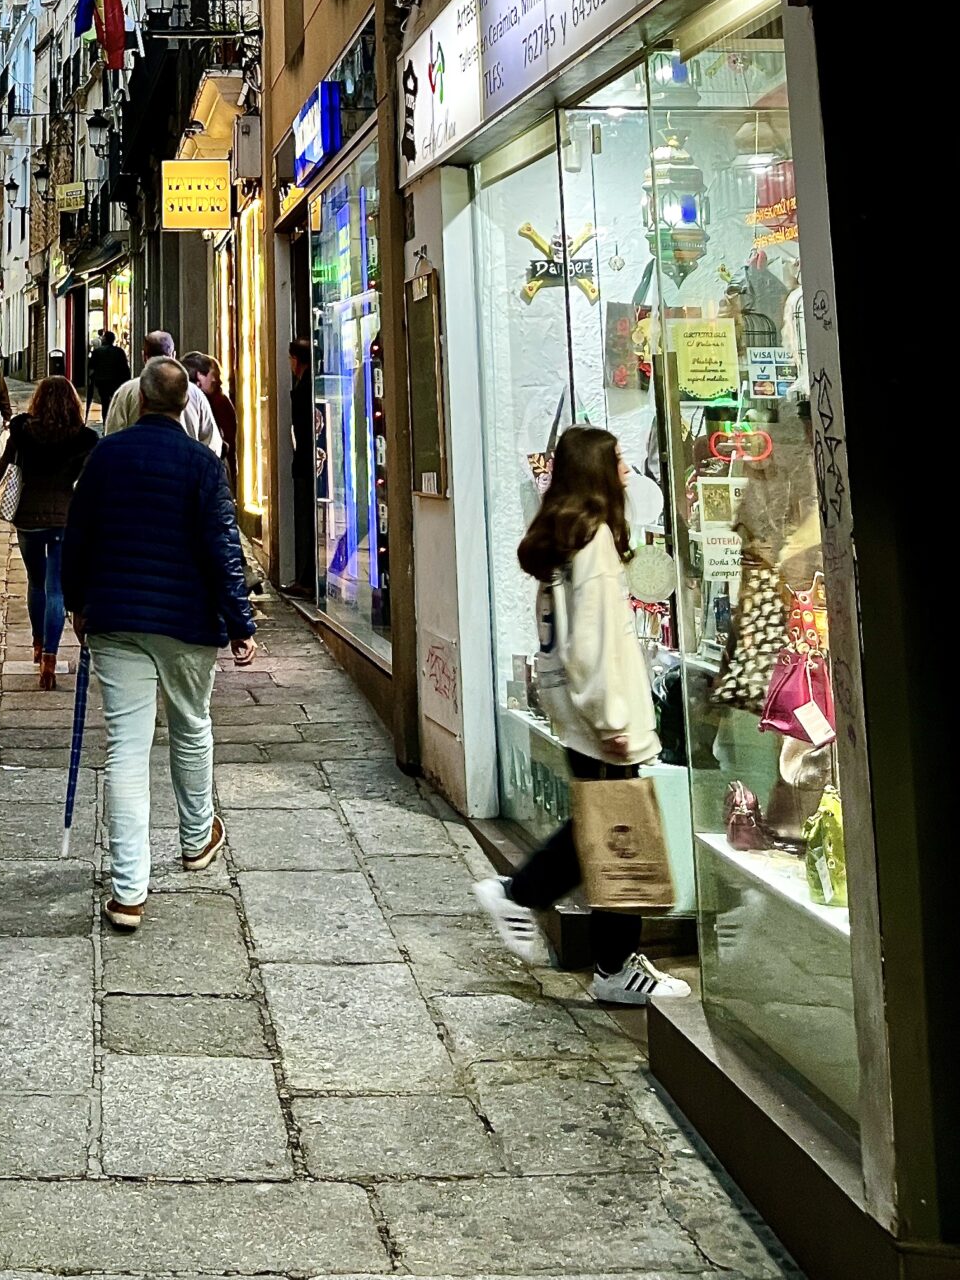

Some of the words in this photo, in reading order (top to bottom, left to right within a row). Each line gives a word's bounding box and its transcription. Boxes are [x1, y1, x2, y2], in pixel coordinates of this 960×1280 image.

[483, 62, 505, 99] TLFS:
[522, 14, 556, 69] 762745
[166, 177, 227, 190] TATTOO
[166, 197, 227, 212] STUDIO
[753, 351, 771, 359] VISA
[706, 536, 741, 545] LOTERÍA
[709, 558, 728, 566] Doña
